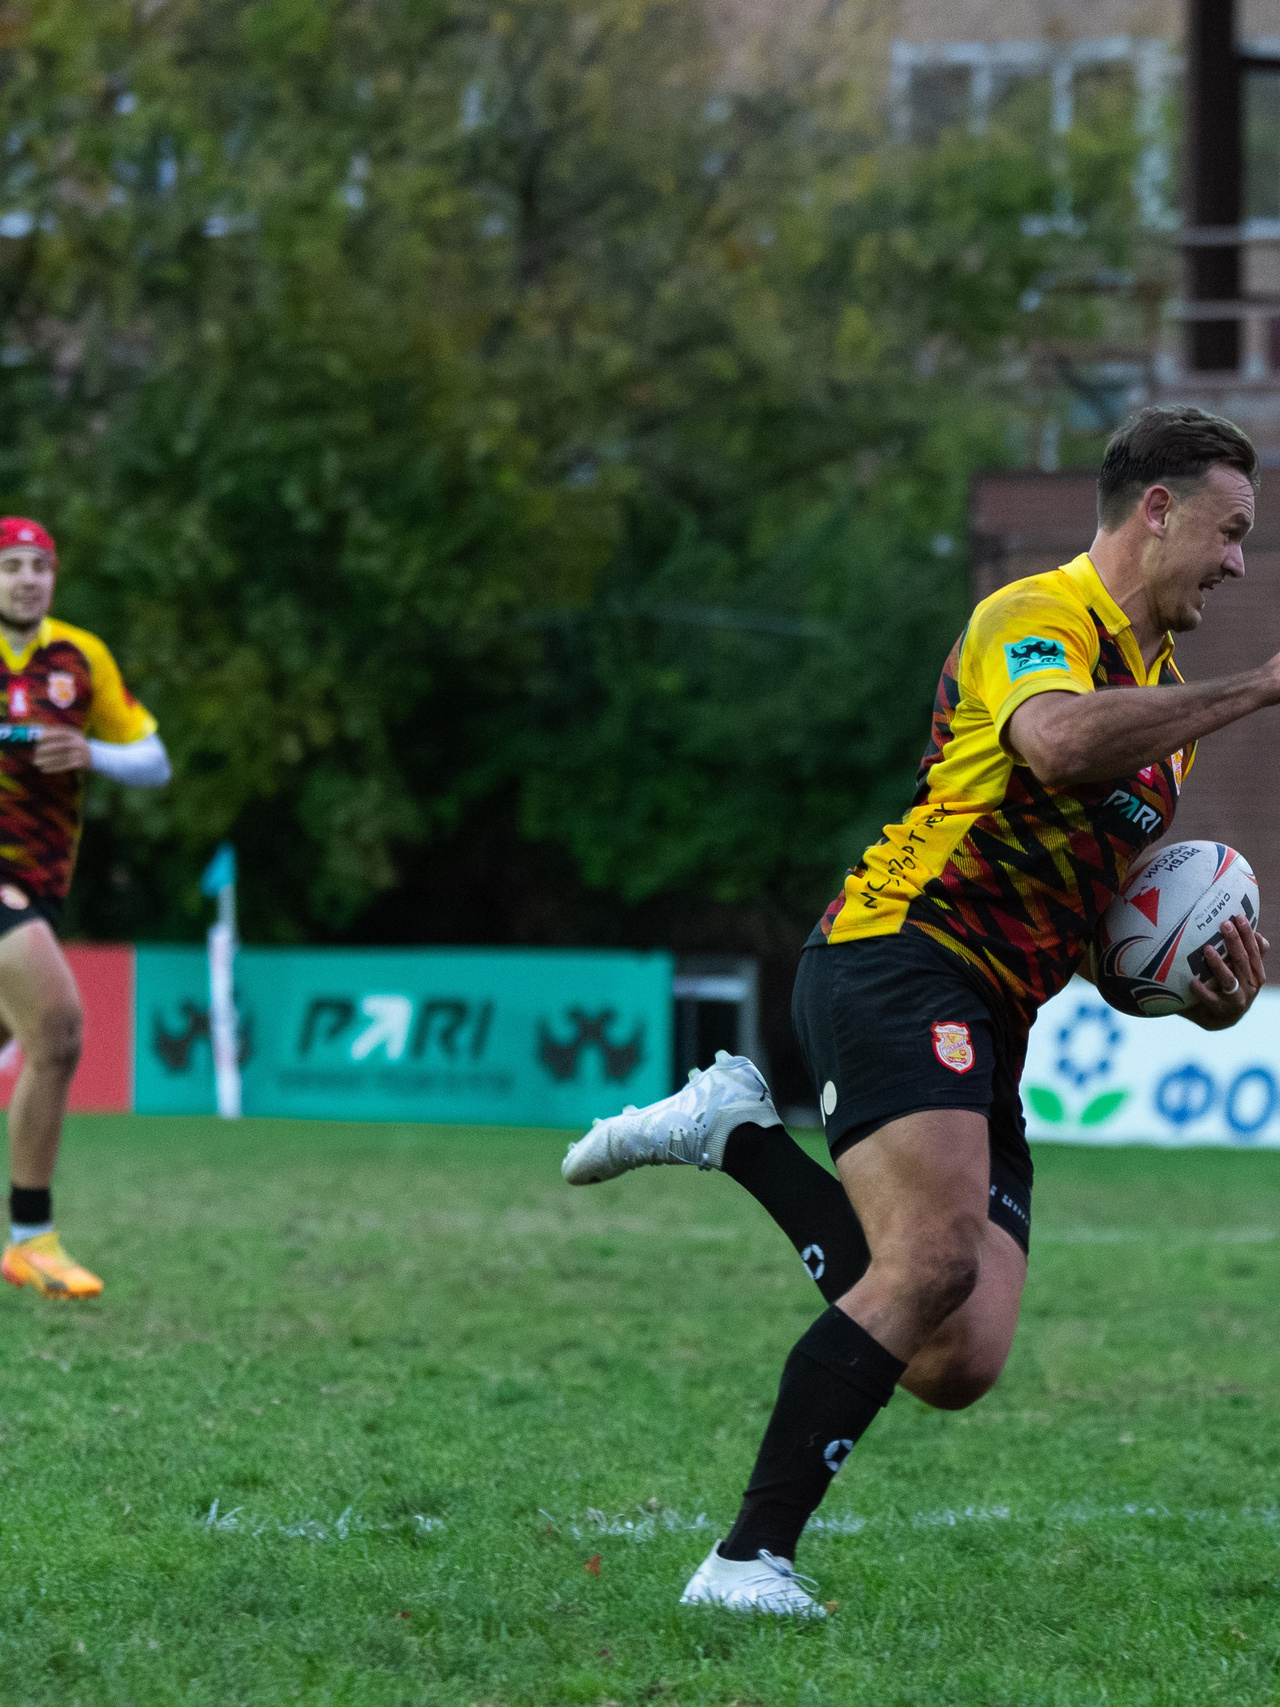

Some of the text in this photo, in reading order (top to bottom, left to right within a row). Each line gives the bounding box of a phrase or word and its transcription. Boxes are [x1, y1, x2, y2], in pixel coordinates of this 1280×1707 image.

[1102, 789, 1162, 834] PARI
[1143, 845, 1189, 879] РОССИИ
[1164, 847, 1202, 873] РЕГБИ
[298, 993, 495, 1060] PARI
